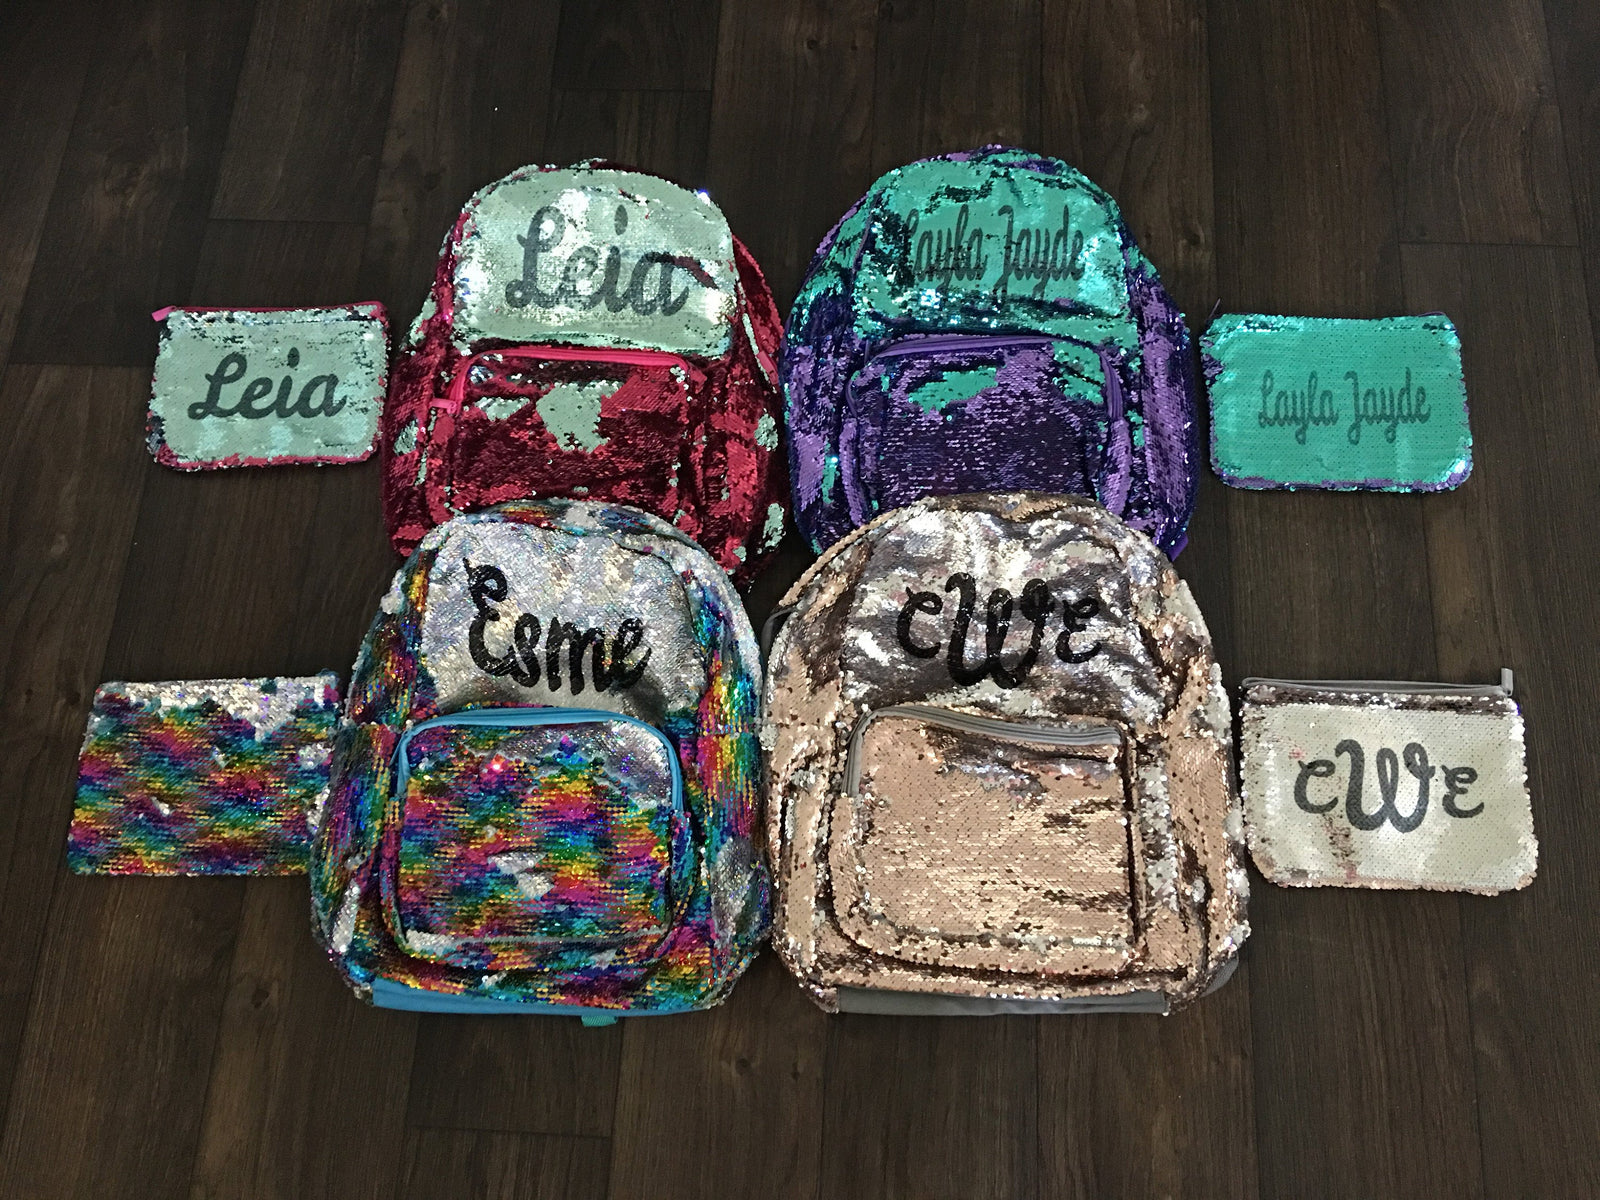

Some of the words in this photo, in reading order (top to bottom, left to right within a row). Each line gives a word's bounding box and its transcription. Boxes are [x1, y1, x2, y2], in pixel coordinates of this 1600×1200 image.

[505, 204, 690, 316] Leia
[993, 204, 1085, 300] Jayde
[188, 346, 348, 420] Leia
[1258, 369, 1339, 445] Layla
[1343, 366, 1431, 445] Jayde
[463, 557, 652, 696] Esme
